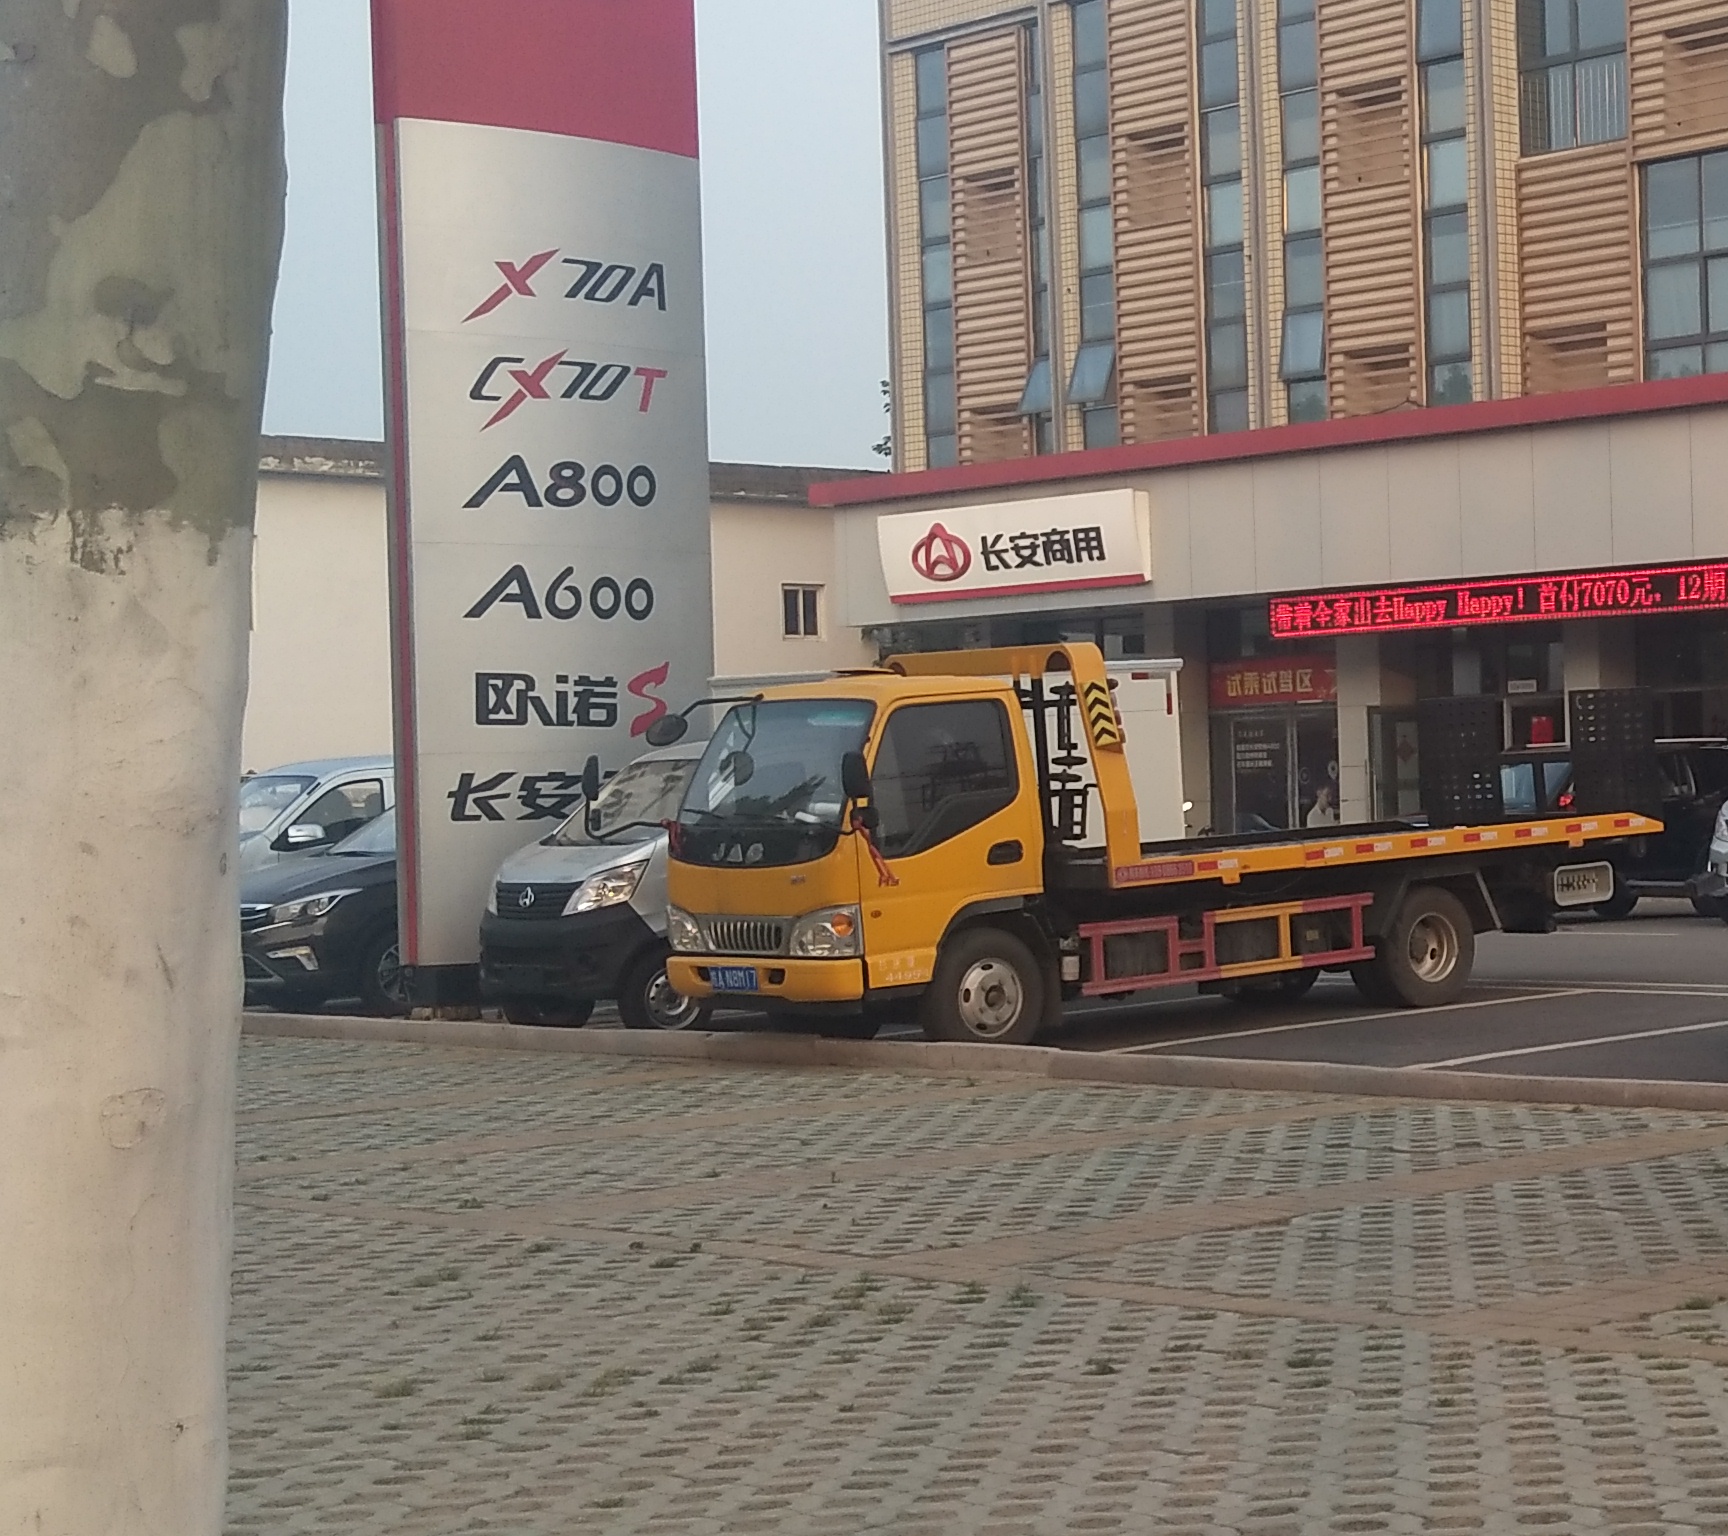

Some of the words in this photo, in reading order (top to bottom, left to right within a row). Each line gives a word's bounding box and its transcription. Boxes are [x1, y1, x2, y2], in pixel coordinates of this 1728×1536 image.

[461, 248, 668, 324] X70A
[468, 348, 668, 432] CX70T
[461, 454, 657, 509] A800
[979, 525, 1106, 572] 长安商用
[462, 563, 655, 620] A600
[1226, 668, 1314, 697] 试乘试驾区
